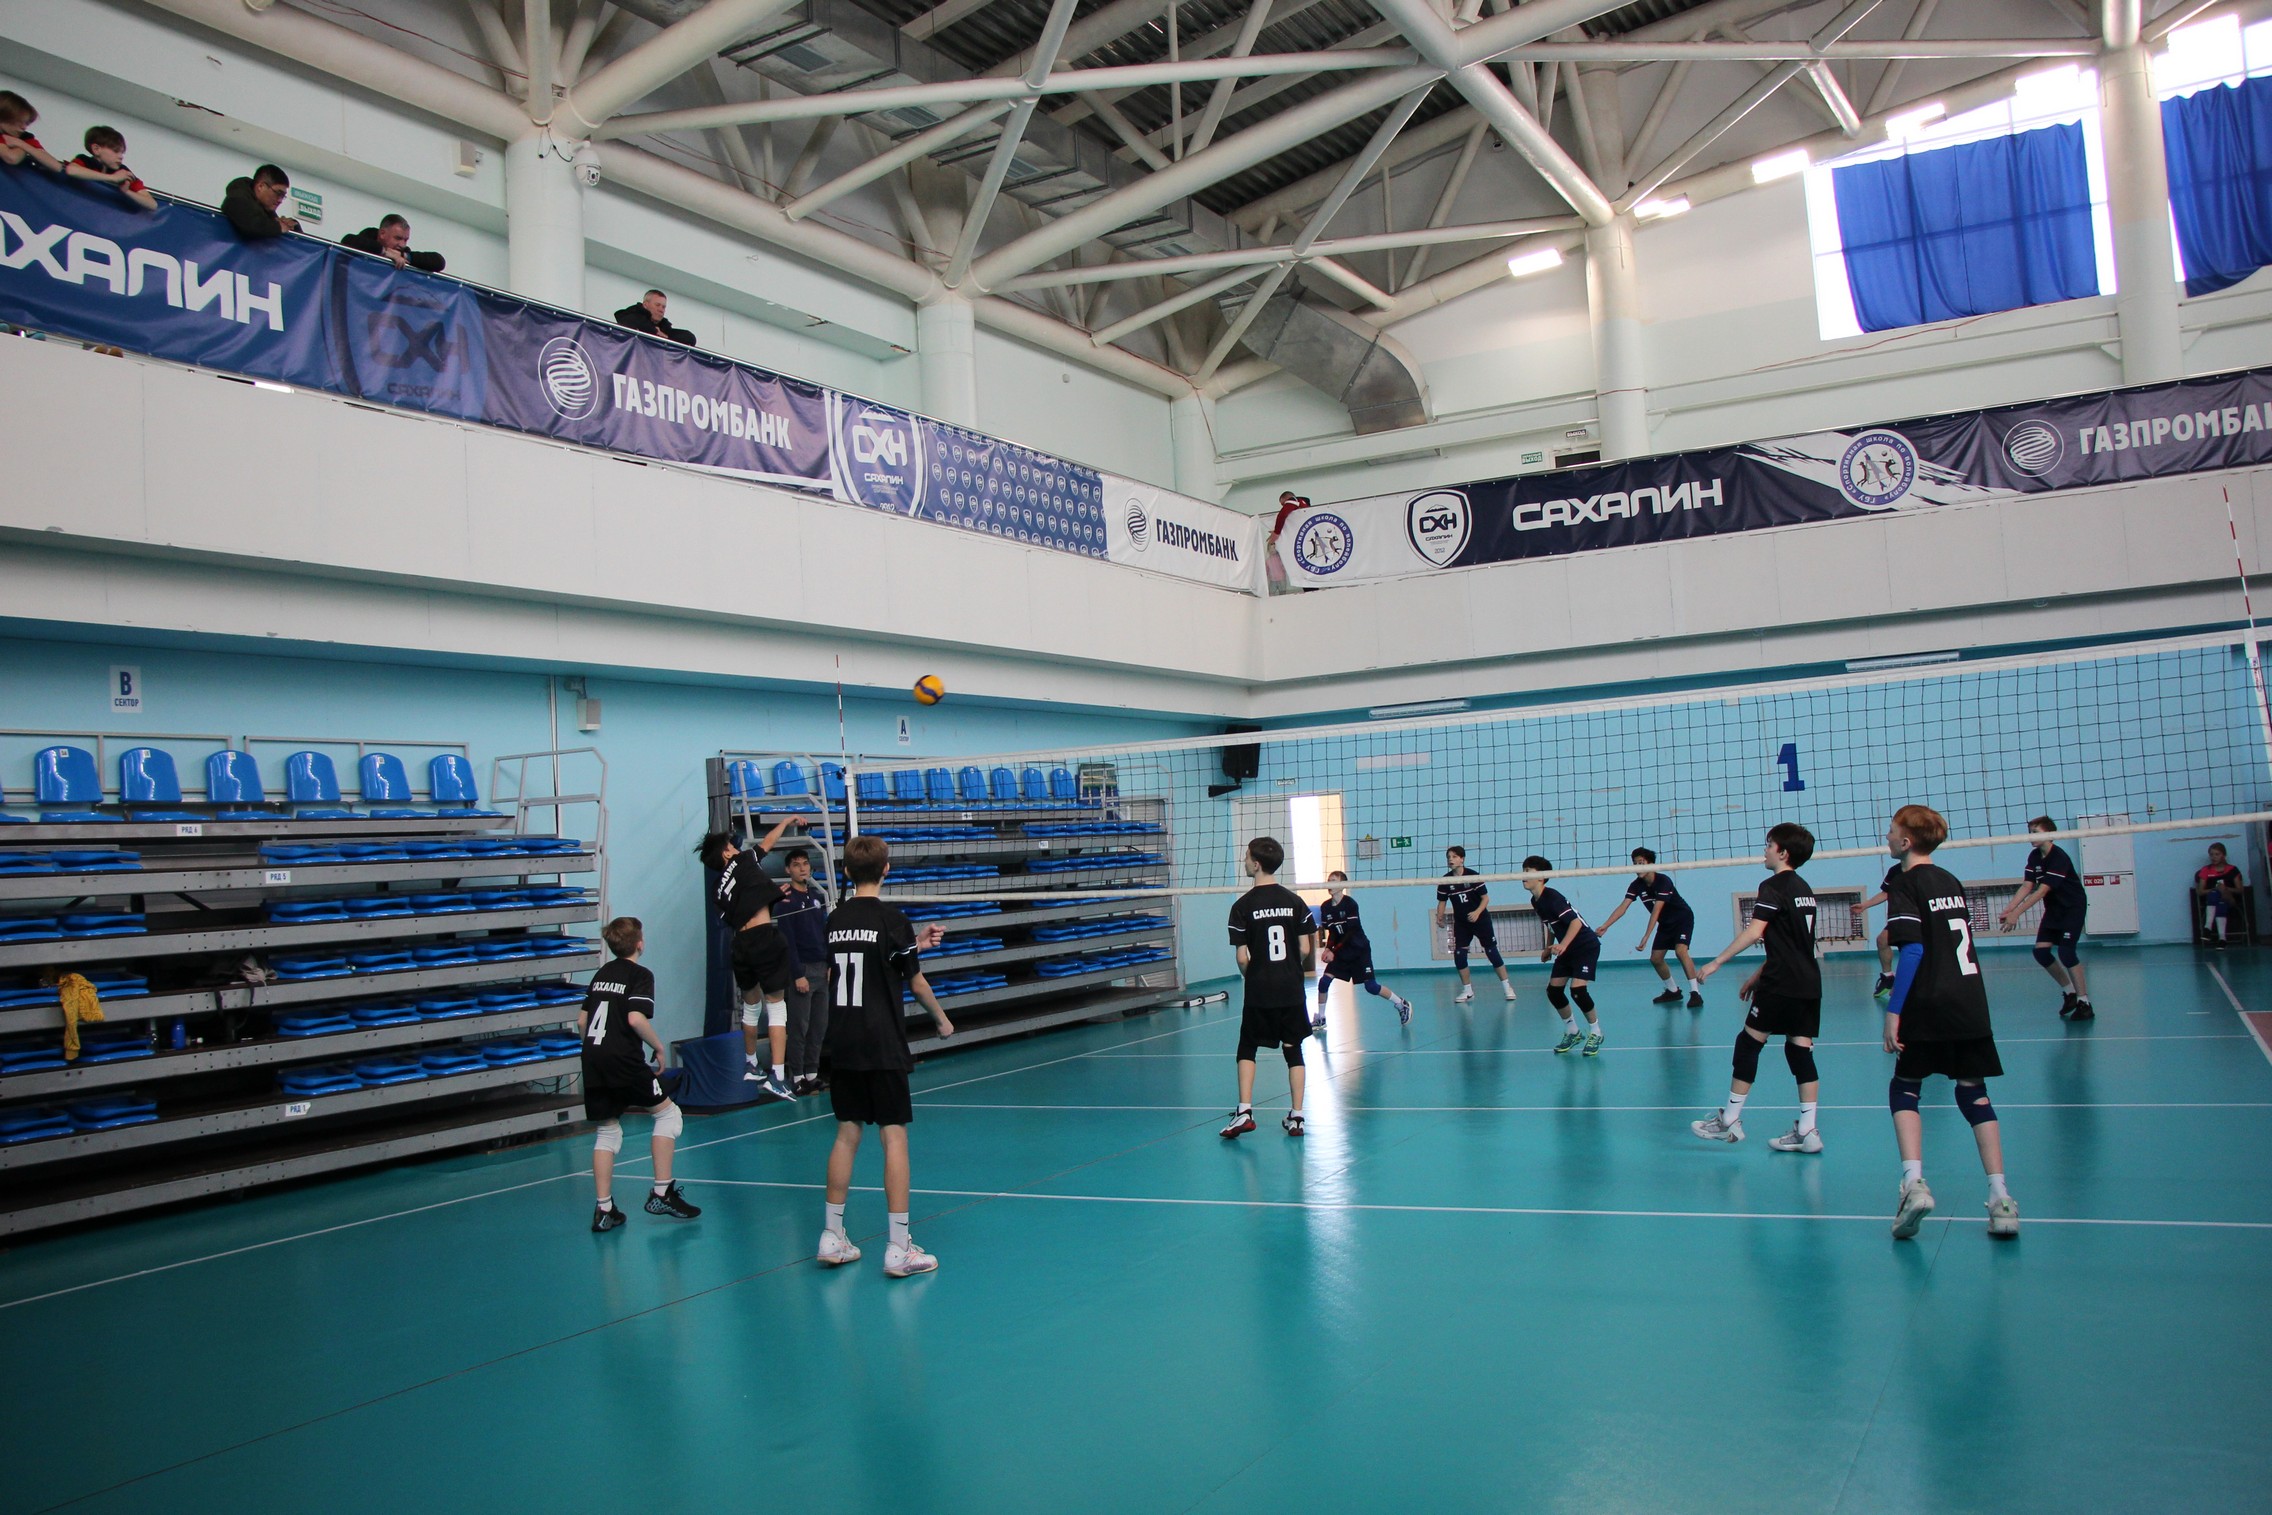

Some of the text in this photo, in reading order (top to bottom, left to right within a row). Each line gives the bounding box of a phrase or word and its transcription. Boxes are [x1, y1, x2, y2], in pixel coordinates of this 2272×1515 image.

[0, 210, 284, 331] ХАЛИН
[612, 372, 792, 450] ГАЗПРОМБАНК
[853, 426, 908, 466] СХН
[1895, 443, 1906, 453] по
[1419, 512, 1458, 533] СХН
[1513, 478, 1723, 531] САХАЛИН
[1156, 518, 1239, 561] ГАЗПРОМБАНК
[115, 698, 139, 707] СЕКТОР
[1776, 742, 1806, 792] 1
[181, 826, 193, 834] РЯД
[1252, 907, 1294, 920] САХАЛИН
[1459, 894, 1469, 903] 12
[828, 929, 878, 943] САХАЛИН
[1268, 924, 1287, 962] 8
[1948, 918, 1978, 976] 2
[592, 981, 626, 995] САХАЛИН
[834, 952, 864, 1008] 11
[587, 1001, 609, 1046] 4
